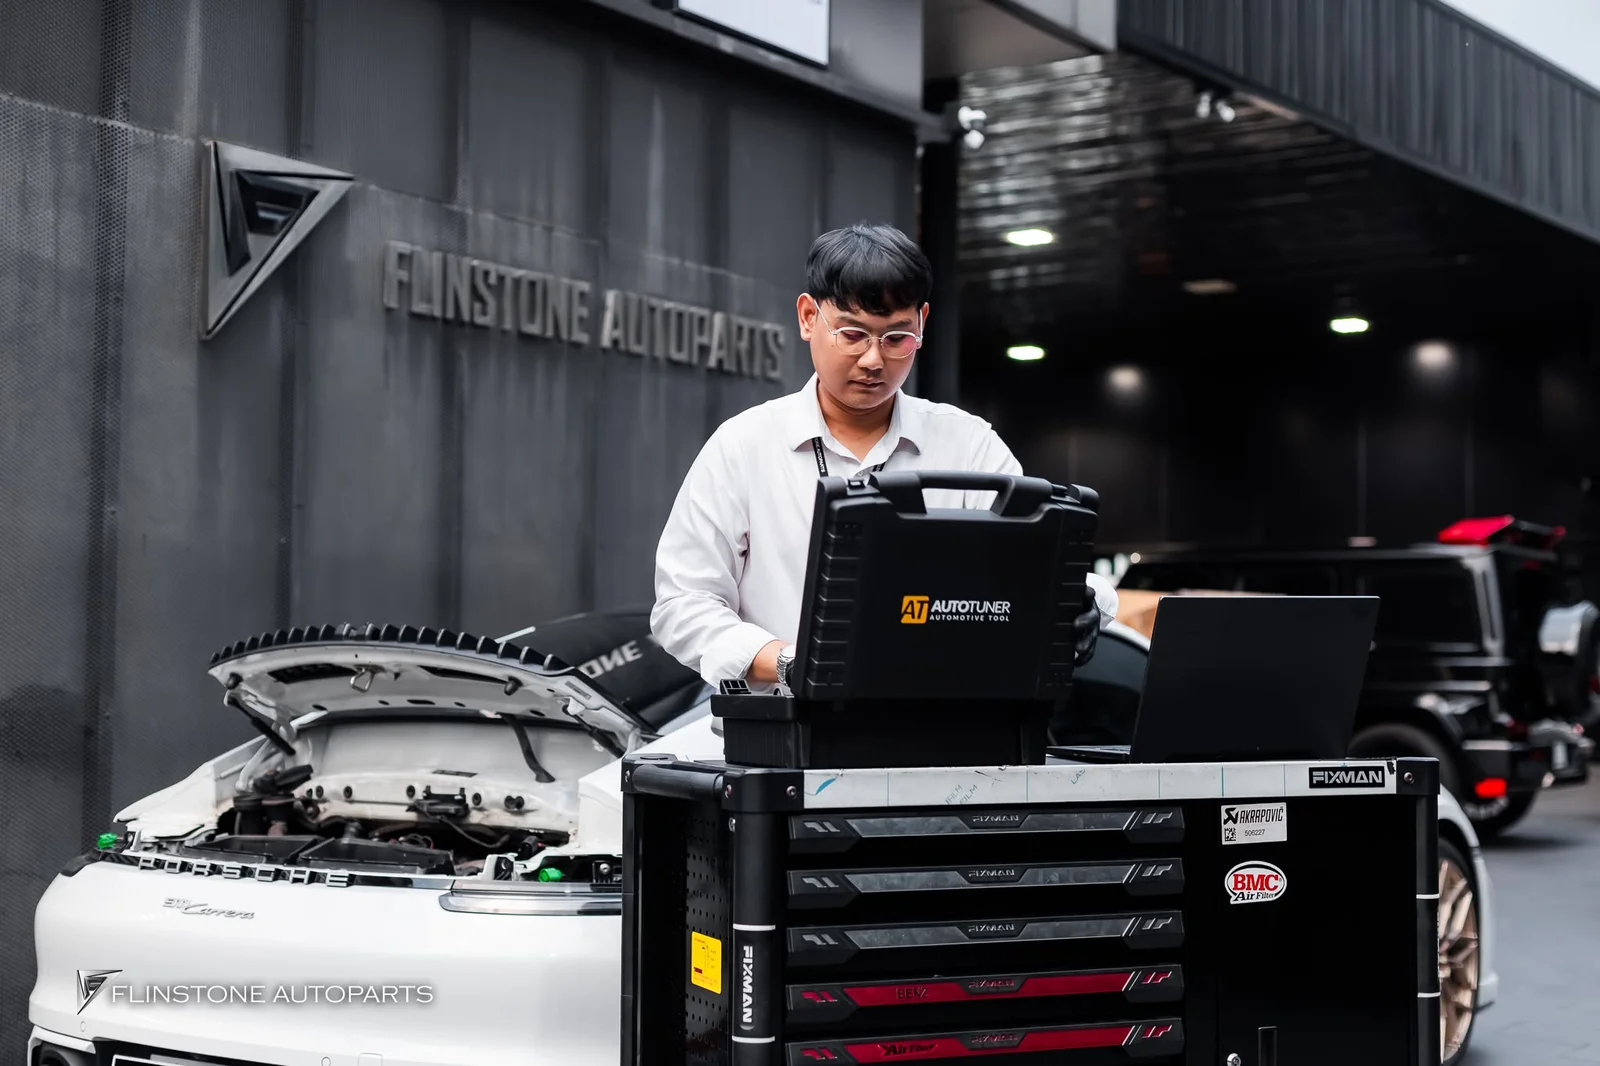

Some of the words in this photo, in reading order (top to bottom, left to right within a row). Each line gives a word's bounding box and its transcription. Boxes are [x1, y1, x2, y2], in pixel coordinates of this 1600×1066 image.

[382, 240, 591, 346] FLINSTONE
[601, 289, 787, 380] AUTOPARTS
[901, 598, 929, 621] AT
[931, 600, 1011, 613] AUTOTUNER
[1312, 770, 1382, 784] FIXMAN
[972, 814, 1019, 822] FIXMAN
[1244, 828, 1266, 837] 506227
[138, 856, 350, 888] PORSCHE
[968, 869, 1015, 877] FIXMAN
[1232, 873, 1279, 891] BMC
[1233, 891, 1255, 901] Air
[1256, 891, 1276, 900] Filter
[181, 903, 255, 920] Carrera
[968, 923, 1015, 932] FIXMAN
[742, 945, 754, 1023] FIXMAN
[896, 986, 929, 999] BENZ
[882, 1044, 908, 1056] Air
